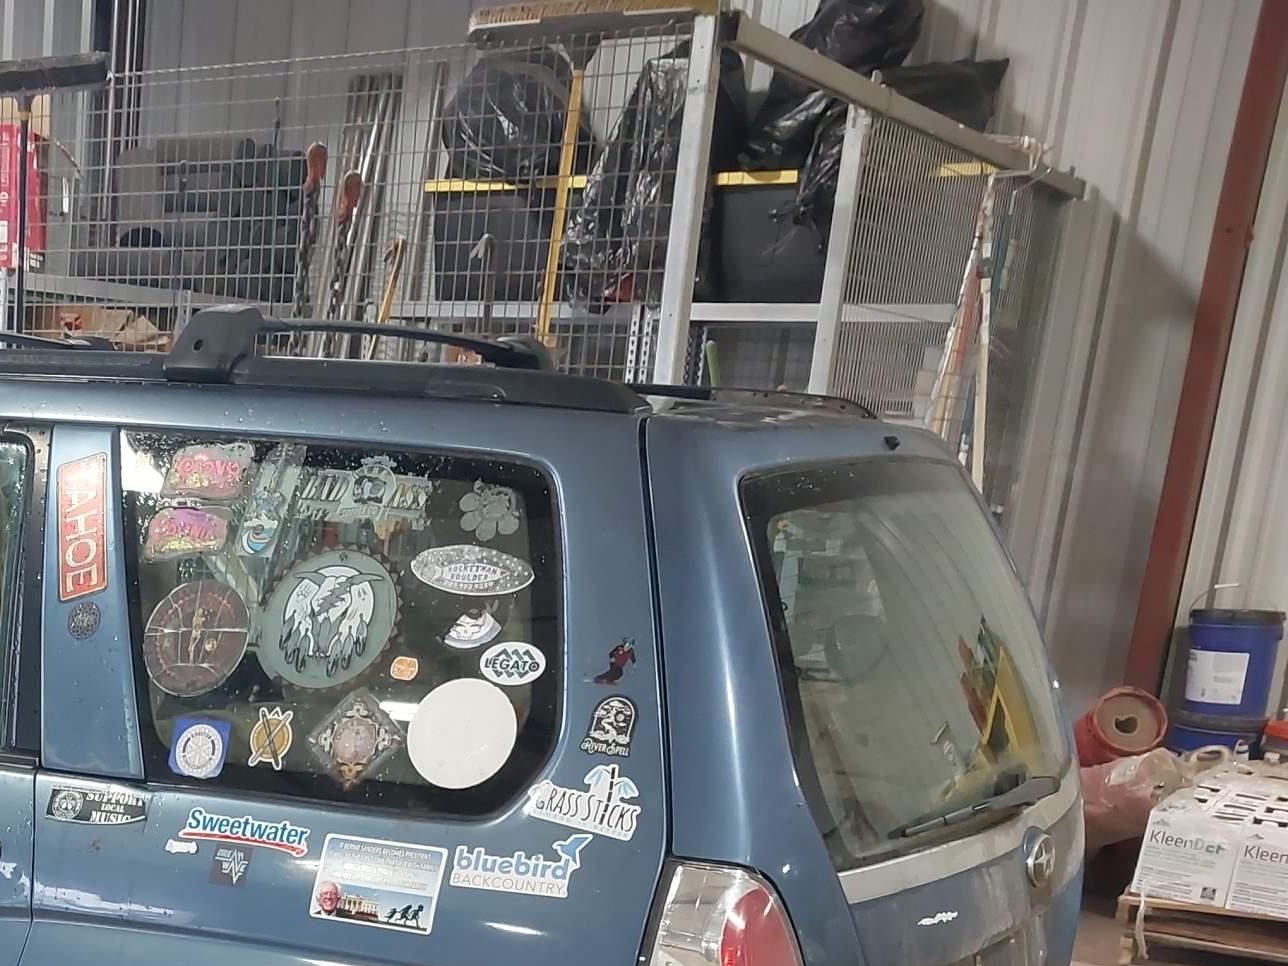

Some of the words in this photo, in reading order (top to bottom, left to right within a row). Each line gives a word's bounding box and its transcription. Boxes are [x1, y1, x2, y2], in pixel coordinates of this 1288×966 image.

[64, 466, 99, 593] AHOE
[450, 572, 489, 582] BOULDER
[484, 656, 541, 673] LEGATO
[89, 811, 132, 825] MUSIC
[100, 803, 125, 813] LOCAL
[580, 784, 638, 832] STICKS
[188, 809, 308, 846] Sweetwater
[456, 847, 571, 881] bluebird
[452, 871, 566, 896] BACKCOUNTRY
